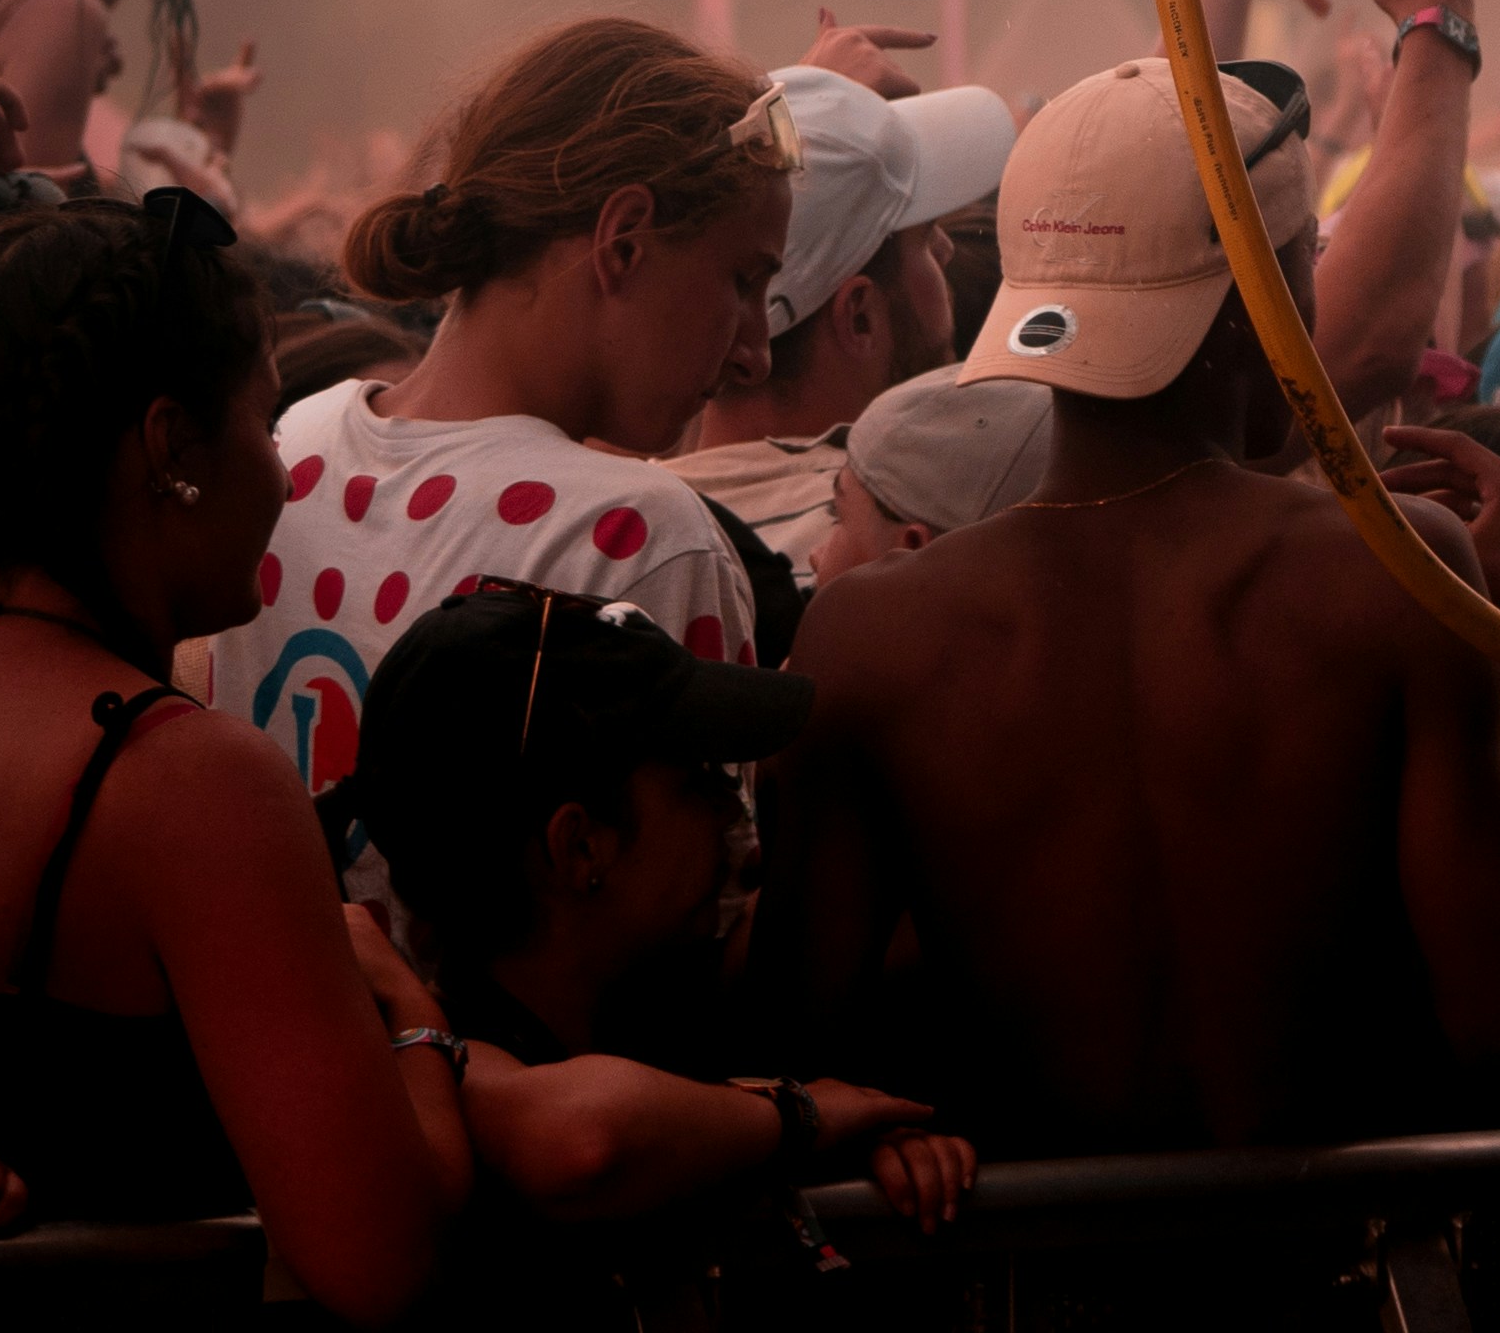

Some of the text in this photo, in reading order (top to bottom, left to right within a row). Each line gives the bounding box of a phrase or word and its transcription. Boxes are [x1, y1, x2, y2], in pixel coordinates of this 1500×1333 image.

[1022, 218, 1126, 236] Calvin Klein Jeans
